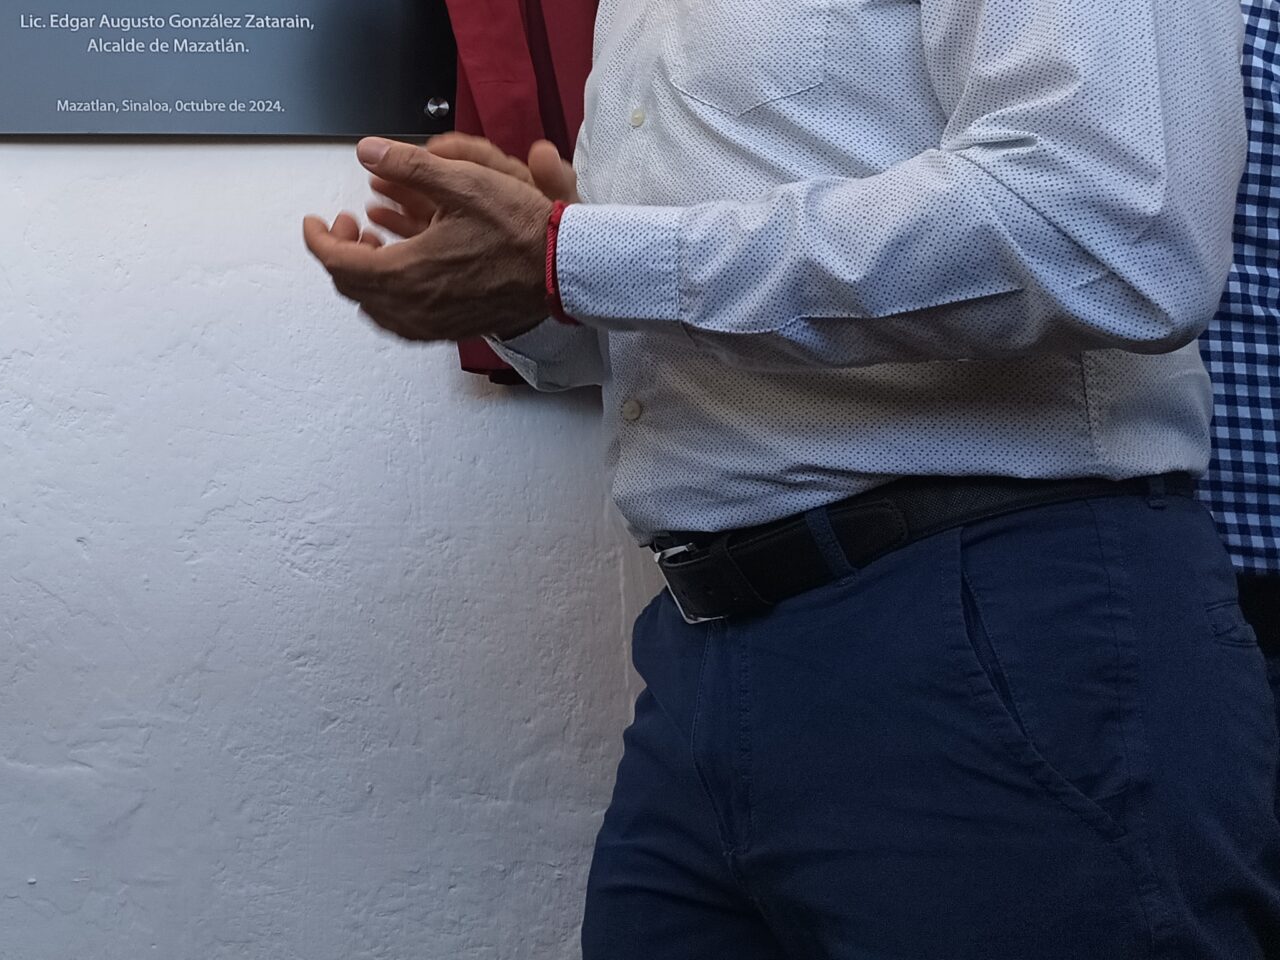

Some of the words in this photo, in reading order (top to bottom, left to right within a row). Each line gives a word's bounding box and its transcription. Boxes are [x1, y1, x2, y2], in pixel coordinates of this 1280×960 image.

[20, 14, 46, 29] Lic.
[50, 13, 96, 32] Edgar
[98, 14, 165, 32] Augusto
[168, 13, 242, 29] González
[244, 14, 315, 31] Zatarain,
[87, 37, 145, 53] Alcalde
[149, 37, 170, 53] de
[173, 37, 250, 53] Mazatlán.
[56, 99, 119, 113] Mazatlan,
[121, 99, 172, 113] Sinaloa,
[228, 99, 246, 112] de
[248, 99, 286, 112] 2024.
